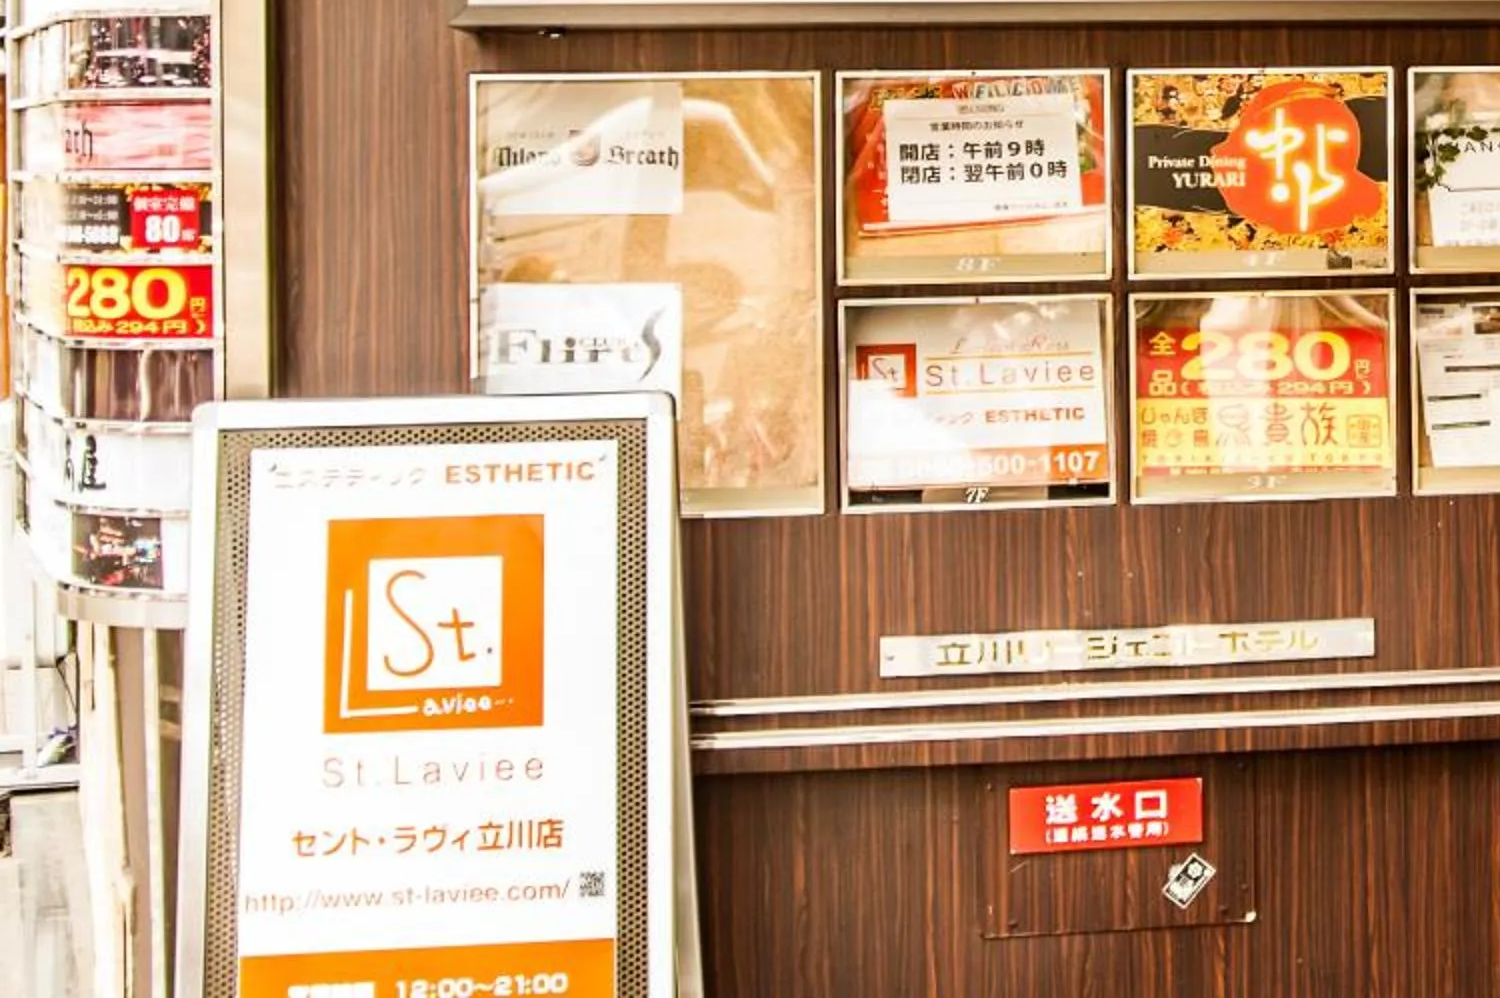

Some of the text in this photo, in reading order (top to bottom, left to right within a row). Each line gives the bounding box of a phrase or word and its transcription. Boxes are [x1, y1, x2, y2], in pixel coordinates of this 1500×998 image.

[1149, 155, 1246, 171] Private Dining
[1172, 172, 1246, 188] YURARI
[985, 406, 1085, 423] ESTHETIC
[446, 461, 596, 484] ESTHETIC
[965, 487, 989, 503] 7F
[1045, 790, 1168, 824] 送水口
[292, 819, 565, 858] セント・ラヴィ立川店
